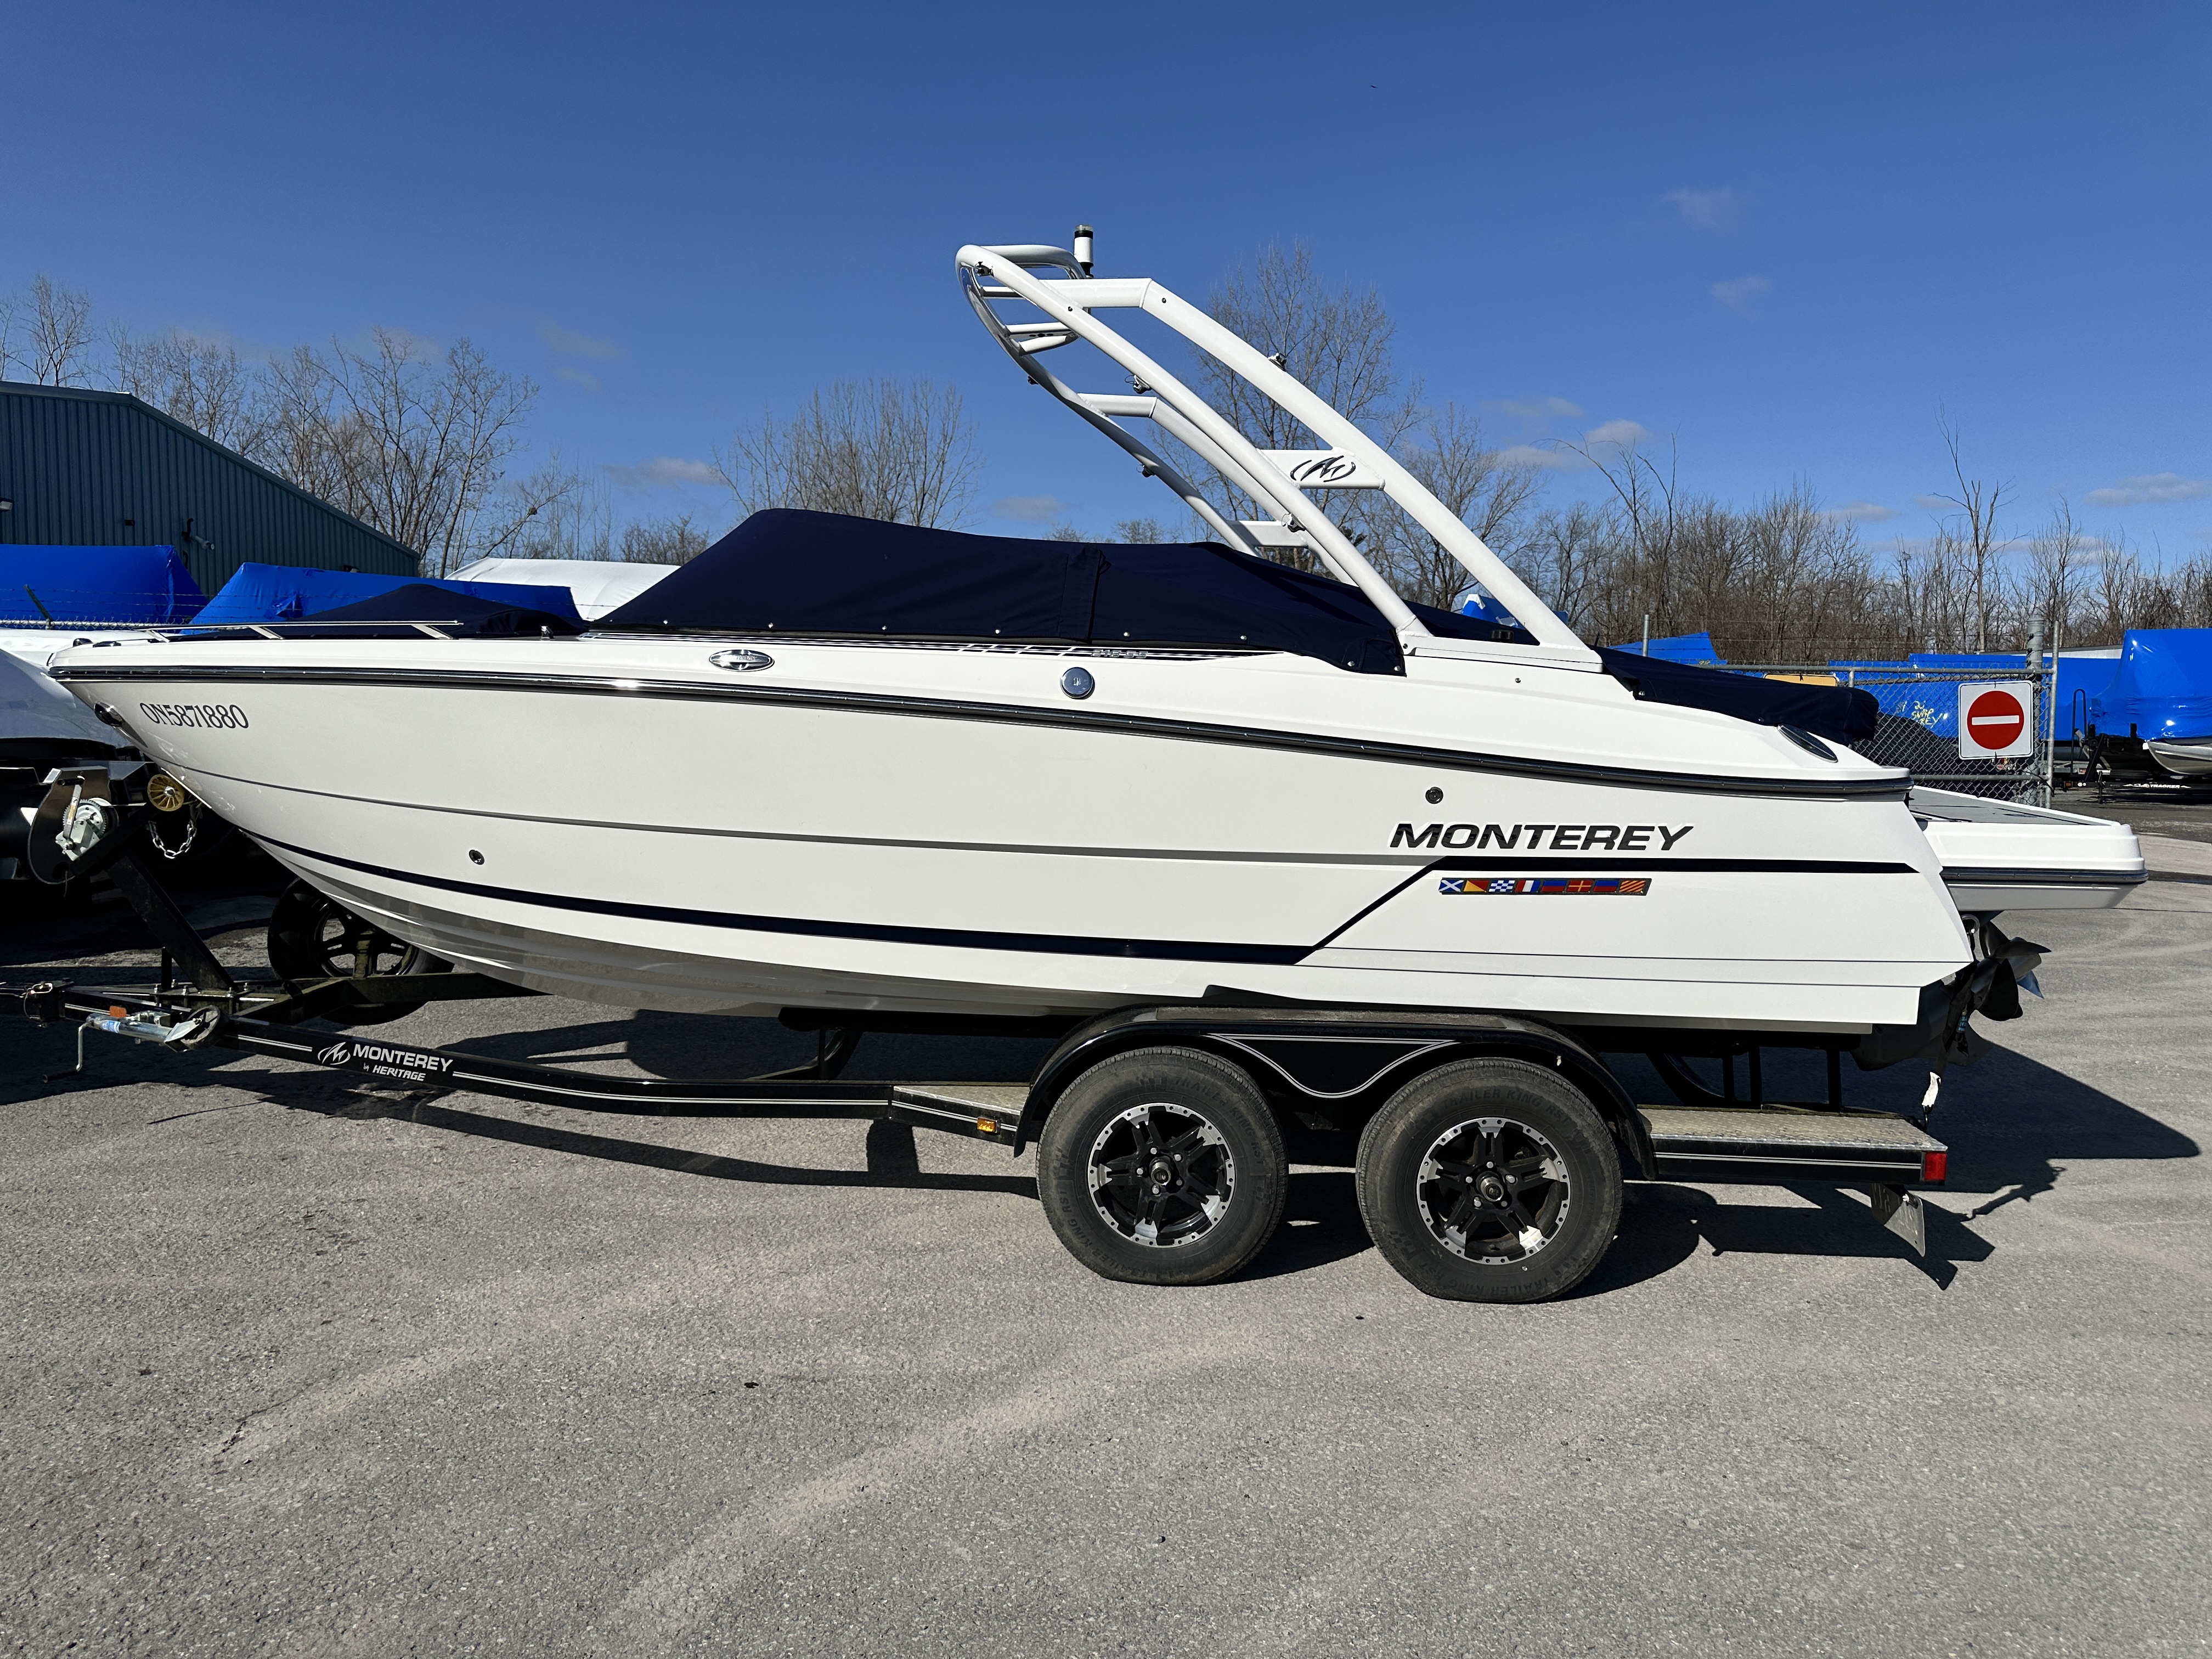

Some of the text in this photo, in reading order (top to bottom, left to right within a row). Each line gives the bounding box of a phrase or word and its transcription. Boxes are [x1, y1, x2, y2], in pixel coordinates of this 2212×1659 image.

[140, 703, 249, 728] ON5871880
[1390, 822, 1694, 851] MONTEREY
[353, 1044, 453, 1071] MONTEREY
[363, 1063, 426, 1081] by HERITAGE
[1506, 1090, 1542, 1107] KING
[1545, 1105, 1572, 1124] RST
[1229, 1107, 1255, 1136] KING
